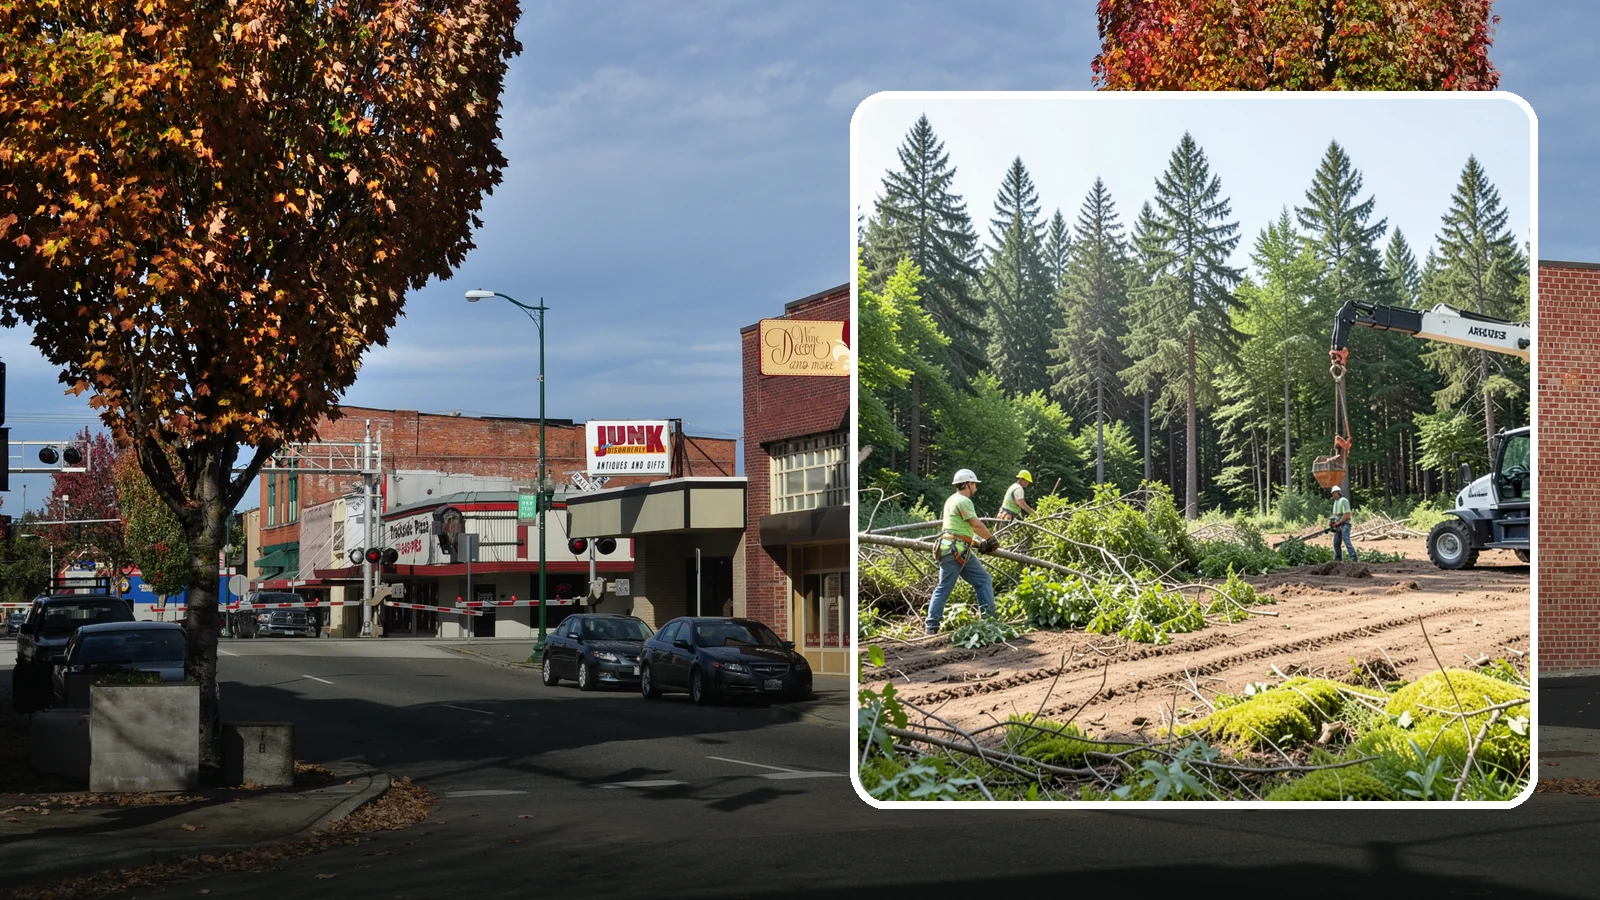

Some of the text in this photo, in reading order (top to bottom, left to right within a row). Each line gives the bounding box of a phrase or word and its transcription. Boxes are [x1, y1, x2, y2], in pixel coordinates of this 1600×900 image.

[764, 328, 830, 365] Decor
[596, 425, 665, 457] JUNK
[607, 446, 645, 454] DISORDERLY
[597, 461, 665, 470] ANTIQUES AND GIFTS
[353, 499, 365, 510] CRO
[414, 519, 429, 535] Pizza
